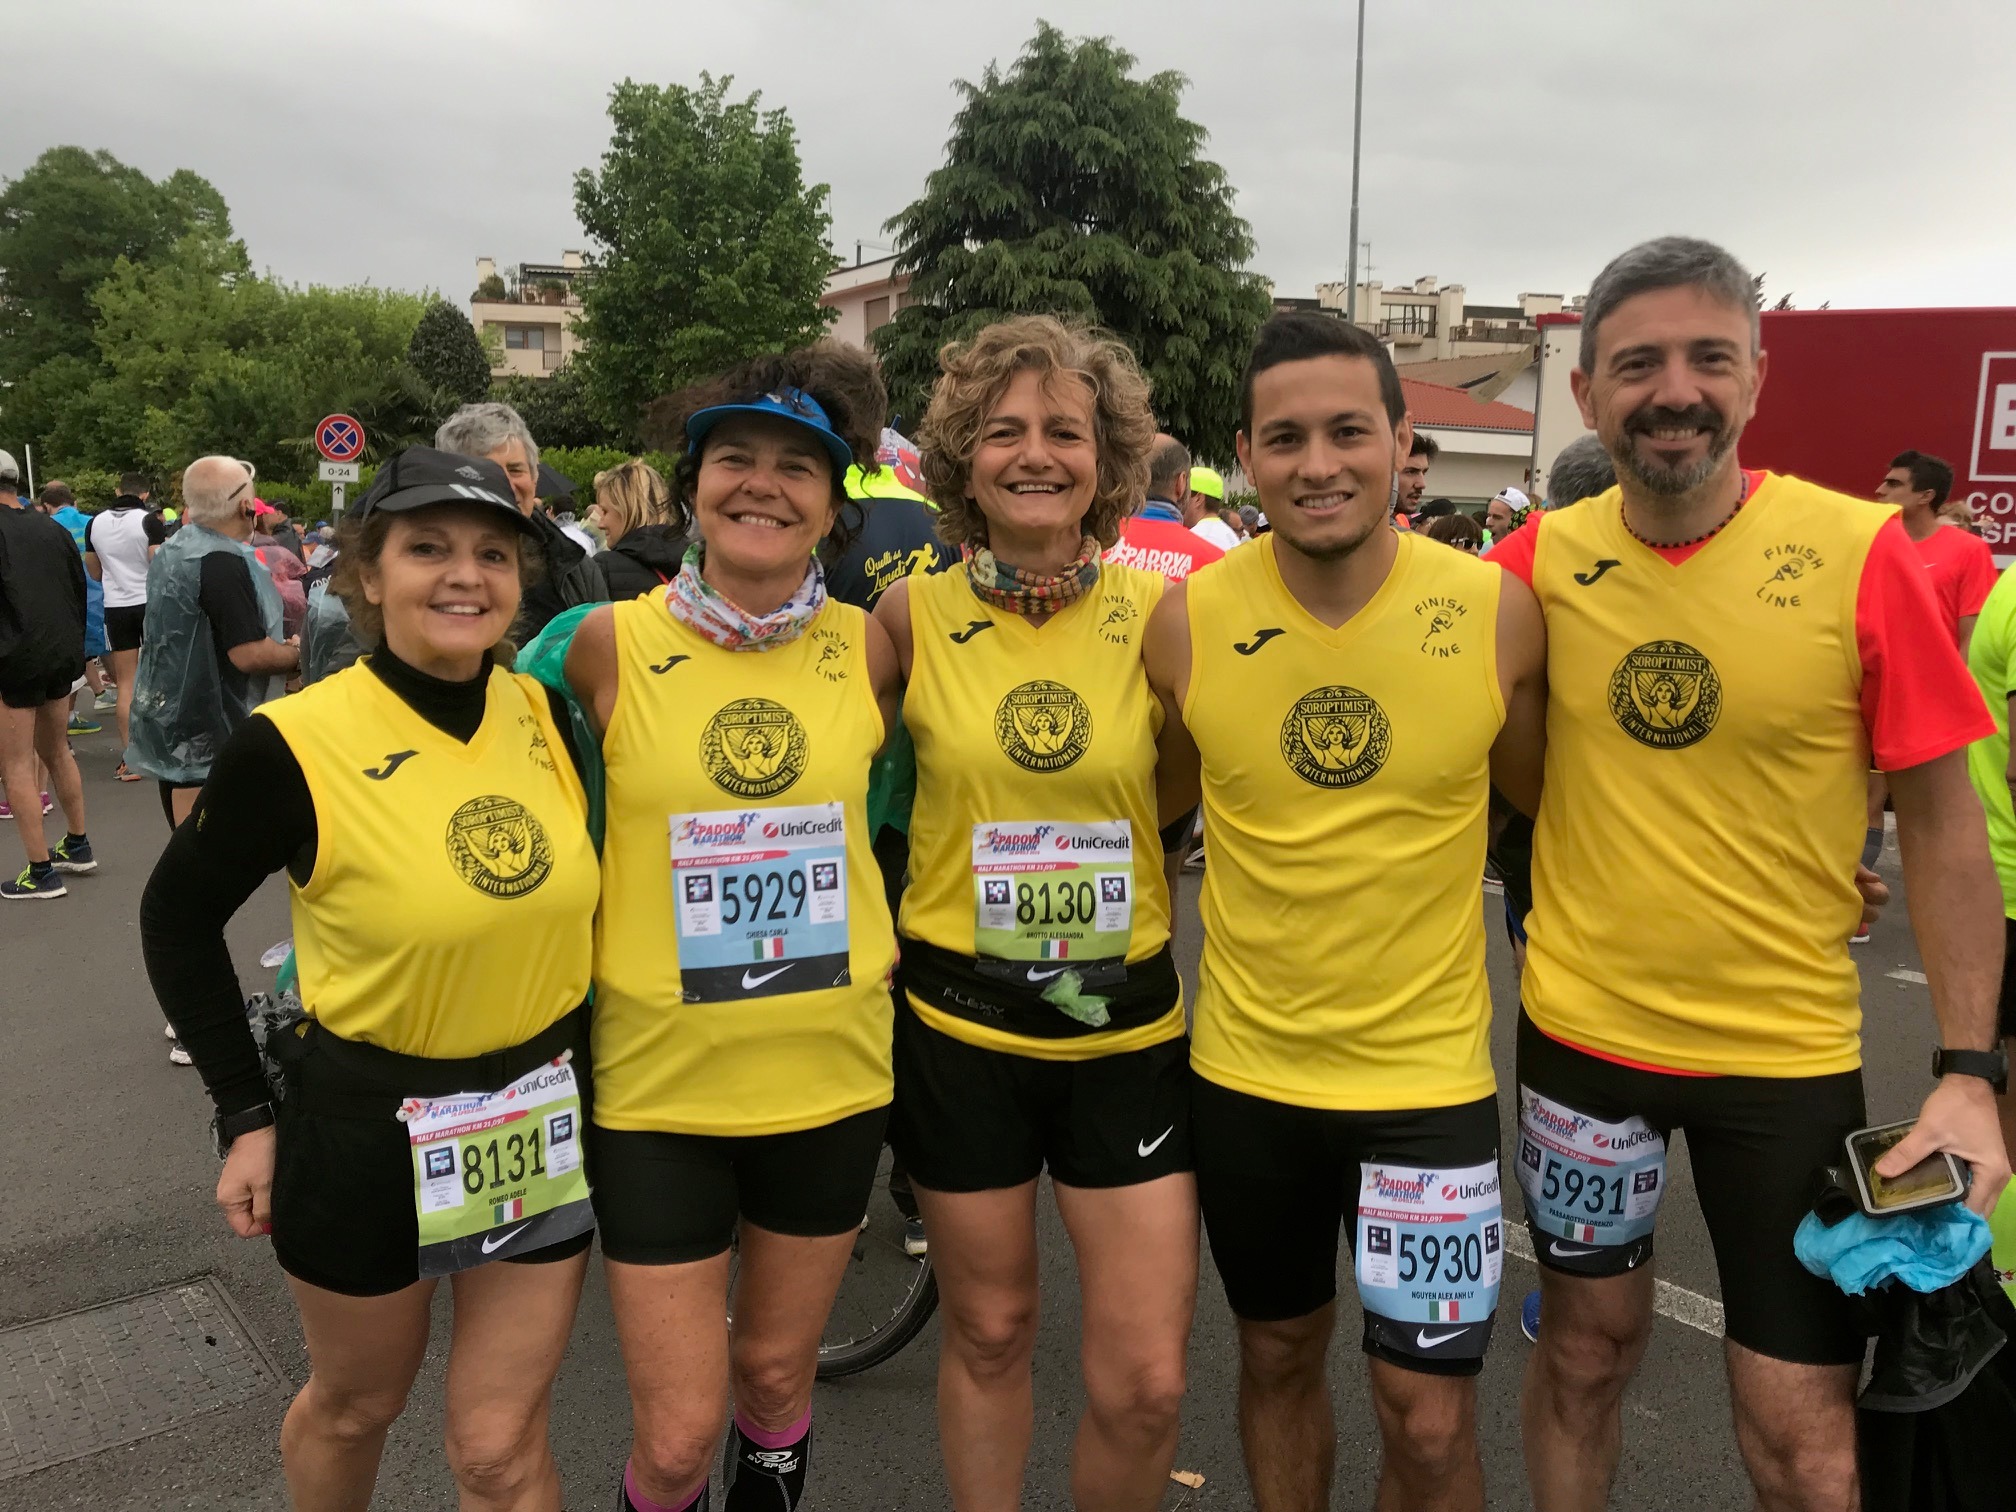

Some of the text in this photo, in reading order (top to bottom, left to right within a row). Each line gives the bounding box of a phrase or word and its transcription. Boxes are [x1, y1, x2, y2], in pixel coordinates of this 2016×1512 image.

[1966, 491, 2016, 515] CO
[1125, 547, 1192, 570] PADOVA
[1764, 544, 1824, 570] FINISH
[1102, 595, 1138, 618] INISH
[1415, 597, 1467, 617] FINISH
[1756, 587, 1801, 608] LINE
[1099, 628, 1129, 644] LINE
[1421, 642, 1461, 658] LINE
[1631, 655, 1704, 671] SOROPTIMIST
[815, 665, 848, 682] LINE
[1011, 693, 1073, 705] SOROPTIMIST
[1300, 700, 1370, 714] SOROPTIMIST
[719, 712, 788, 725] SOROPTIMIST
[1626, 718, 1703, 744] INTERNATIONAL
[1011, 745, 1080, 768] INTERNATIONAL
[718, 769, 796, 794] INTERNATIONAL
[1299, 761, 1375, 784] INTERNATIONAL
[698, 822, 746, 836] PADOVA
[781, 818, 843, 837] UniCredit
[999, 834, 1041, 847] PADOVA
[1071, 835, 1130, 850] UniCredit
[722, 870, 807, 925] 5929
[1016, 881, 1096, 925] 8130
[518, 1067, 572, 1096] UniCredit
[1538, 1106, 1578, 1133] PADOVA
[416, 1134, 434, 1143] HALF
[434, 1125, 471, 1139] MARATHON
[472, 1122, 482, 1131] KM
[463, 1128, 545, 1195] 8131
[1379, 1188, 1422, 1200] MARATHON
[1383, 1178, 1425, 1193] PADOVA
[1542, 1158, 1624, 1215] 5931
[489, 1188, 527, 1206] ROMEO ADELE
[1363, 1208, 1377, 1216] HALF
[1376, 1210, 1409, 1220] MARATHON
[1420, 1215, 1443, 1223] 21,097
[1399, 1233, 1482, 1283] 5930
[1411, 1291, 1475, 1300] NGUYEN ALEX ANH LY
[763, 1457, 800, 1469] SPORT
